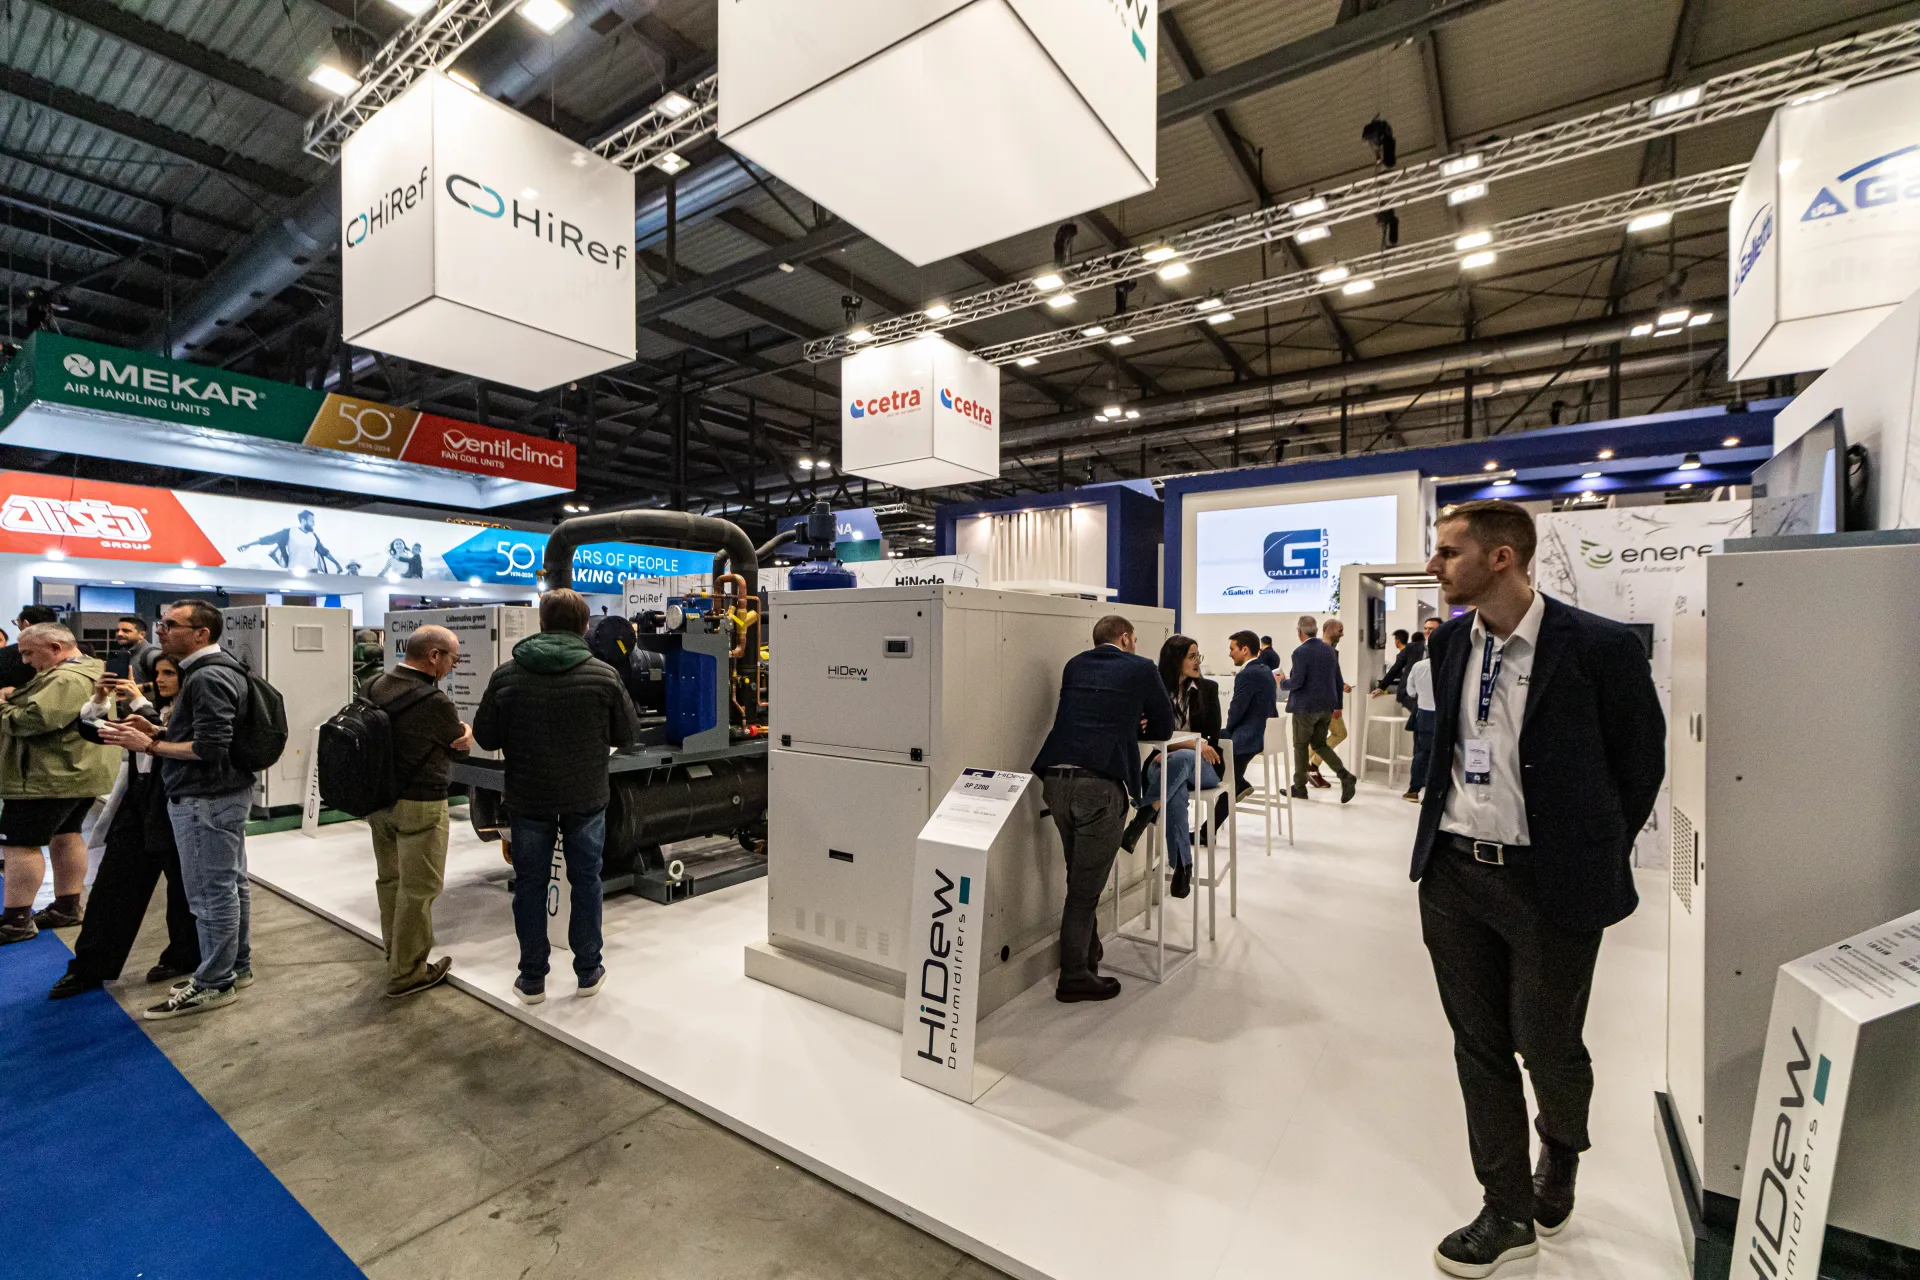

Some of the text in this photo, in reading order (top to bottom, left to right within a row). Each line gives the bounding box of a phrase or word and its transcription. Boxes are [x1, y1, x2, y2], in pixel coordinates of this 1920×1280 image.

[370, 166, 428, 235] HiRef
[512, 199, 628, 270] HiRef
[64, 382, 211, 417] AIR HANDLING UNITS
[99, 359, 258, 410] MEKAR
[867, 389, 921, 416] cetra
[954, 396, 993, 425] cetra
[441, 450, 505, 469] FAN COIL UNITS
[443, 429, 564, 469] Ventilclima
[100, 541, 152, 550] GROUP
[496, 541, 679, 576] 50 ARS OF PEOPLE
[1267, 568, 1320, 577] GALLETTI
[639, 593, 663, 603] HiRef
[236, 614, 257, 630] HiRef
[828, 665, 868, 676] HiDew
[917, 868, 956, 1065] HiDew
[947, 913, 967, 1070] Dehumidifiers
